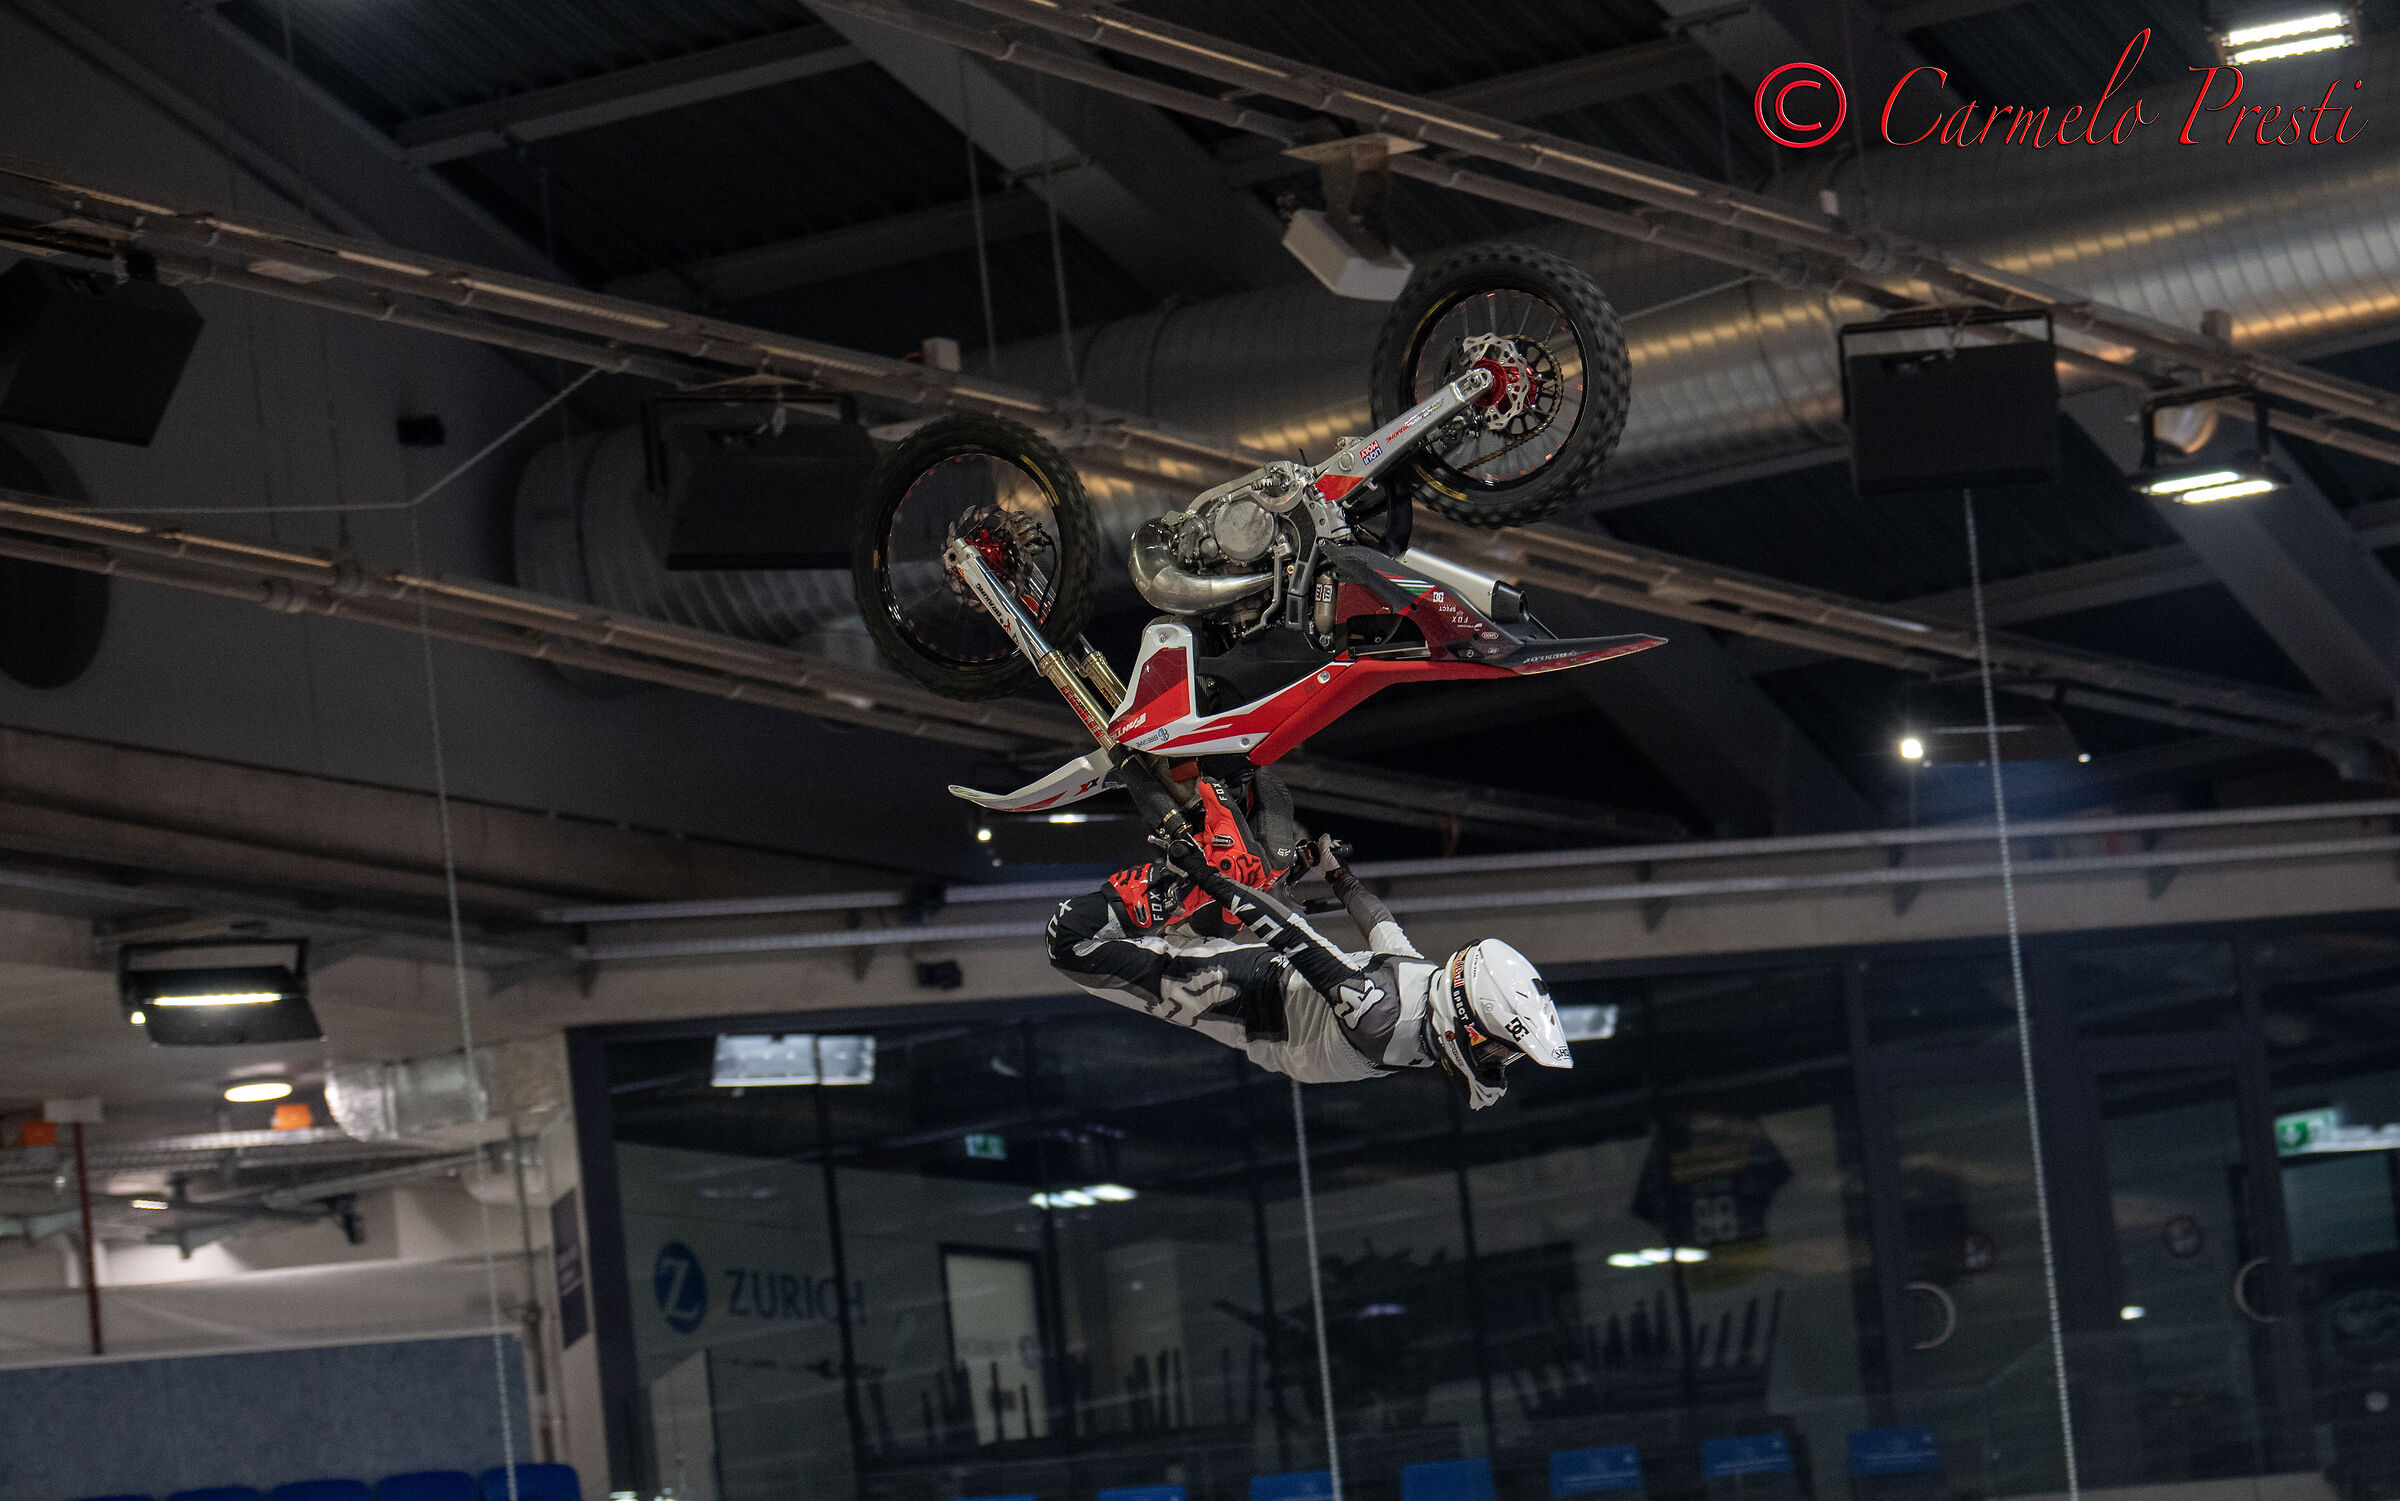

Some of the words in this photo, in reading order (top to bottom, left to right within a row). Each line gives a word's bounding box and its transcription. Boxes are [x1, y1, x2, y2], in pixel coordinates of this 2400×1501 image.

[1361, 440, 1379, 458] MOLY
[1363, 447, 1383, 465] LIQUI
[976, 583, 1002, 617] BRAKING
[1452, 616, 1469, 624] FOX
[1212, 783, 1228, 801] FOX
[1149, 891, 1164, 921] FOX
[1453, 990, 1469, 1021] SPECT
[1505, 1016, 1530, 1043] DC
[724, 1266, 868, 1325] ZURICH
